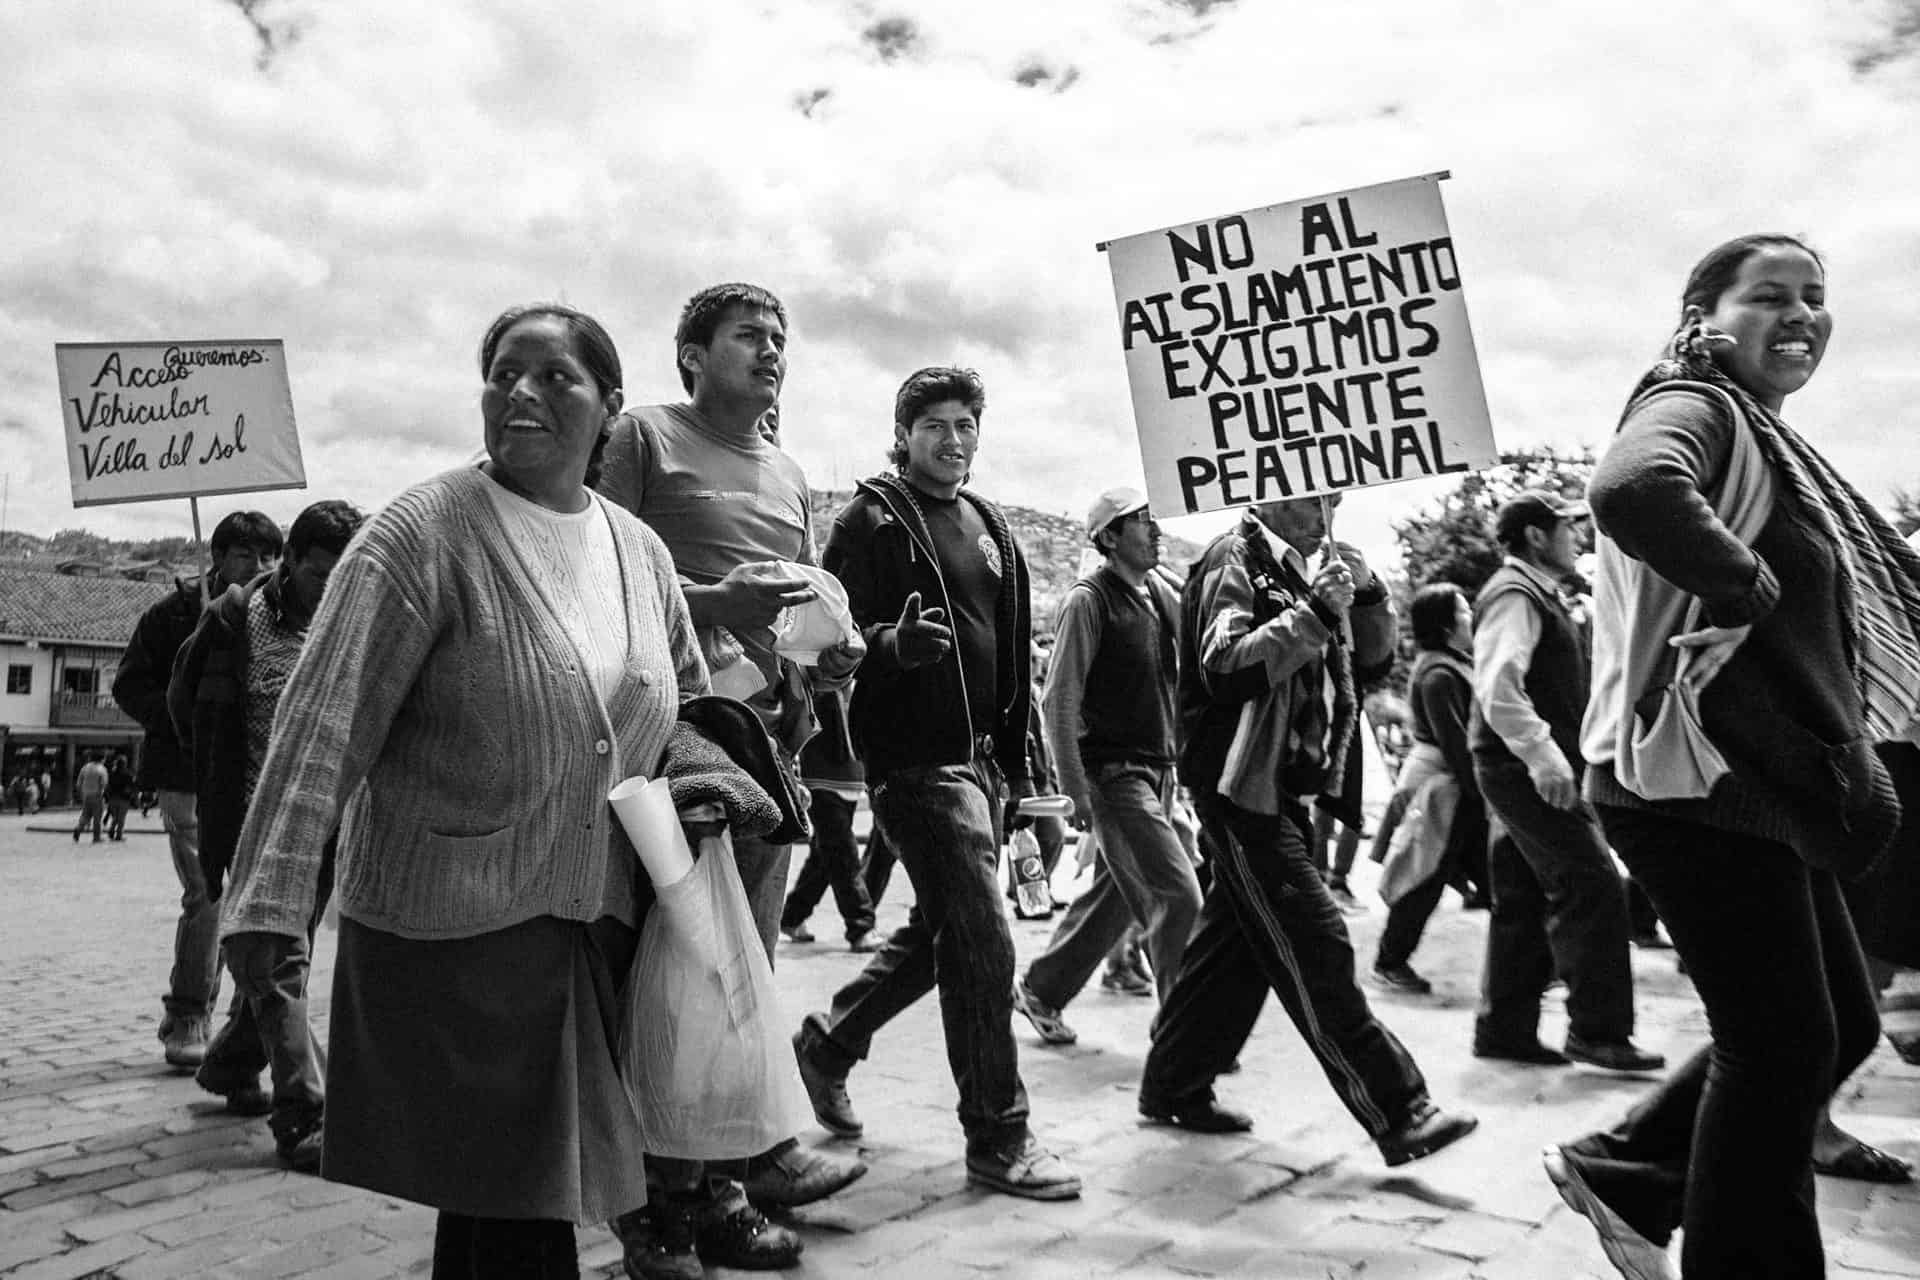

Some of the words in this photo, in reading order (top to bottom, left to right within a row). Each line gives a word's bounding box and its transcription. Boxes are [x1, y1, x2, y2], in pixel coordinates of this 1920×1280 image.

[1166, 215, 1254, 282] NO
[1300, 197, 1377, 255] AL
[1122, 236, 1462, 350] AISLAMIENTO
[90, 352, 193, 387] Acceso
[1161, 297, 1439, 399] EXIGIMOS
[68, 387, 210, 433] Vehicular
[78, 435, 149, 480] Villa
[160, 431, 194, 469] del
[199, 413, 247, 464] sol
[1208, 366, 1427, 449] PUENTE
[1176, 420, 1469, 514] PEATONAL
